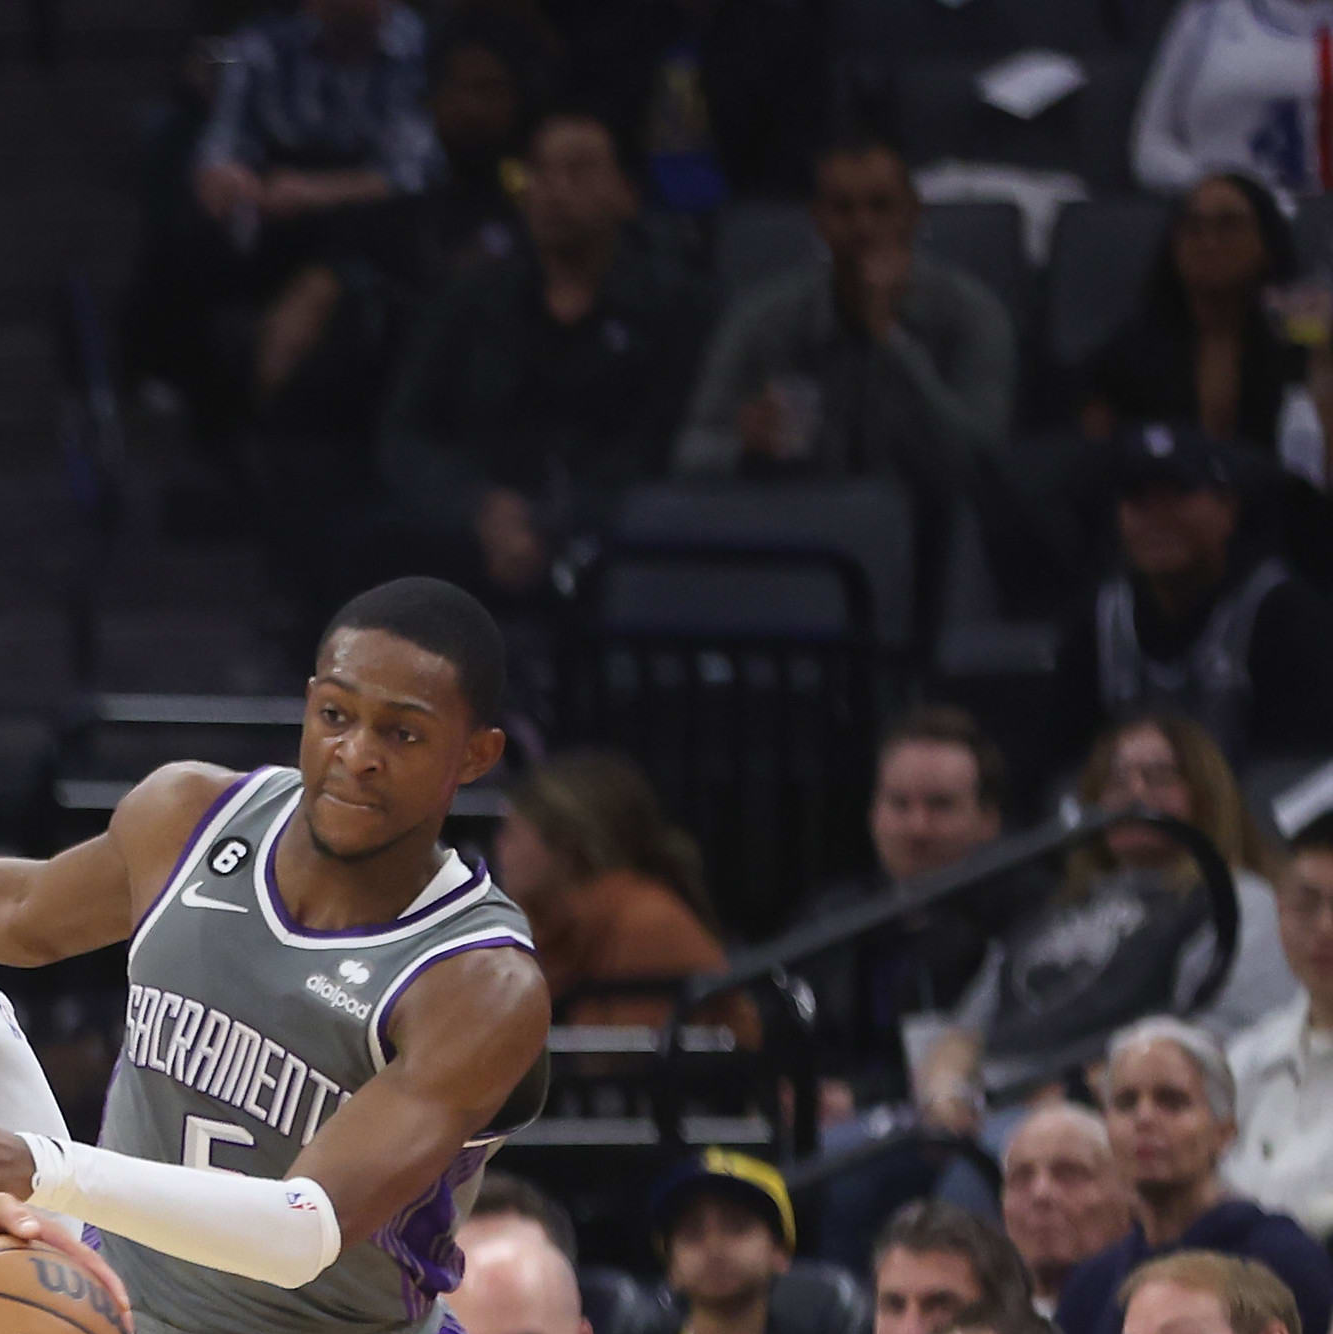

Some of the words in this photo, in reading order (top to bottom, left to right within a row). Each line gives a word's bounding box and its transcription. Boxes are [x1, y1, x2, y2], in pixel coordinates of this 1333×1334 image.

[212, 841, 247, 875] 6
[305, 974, 373, 1021] dialpad
[126, 983, 355, 1147] SACRAMENT
